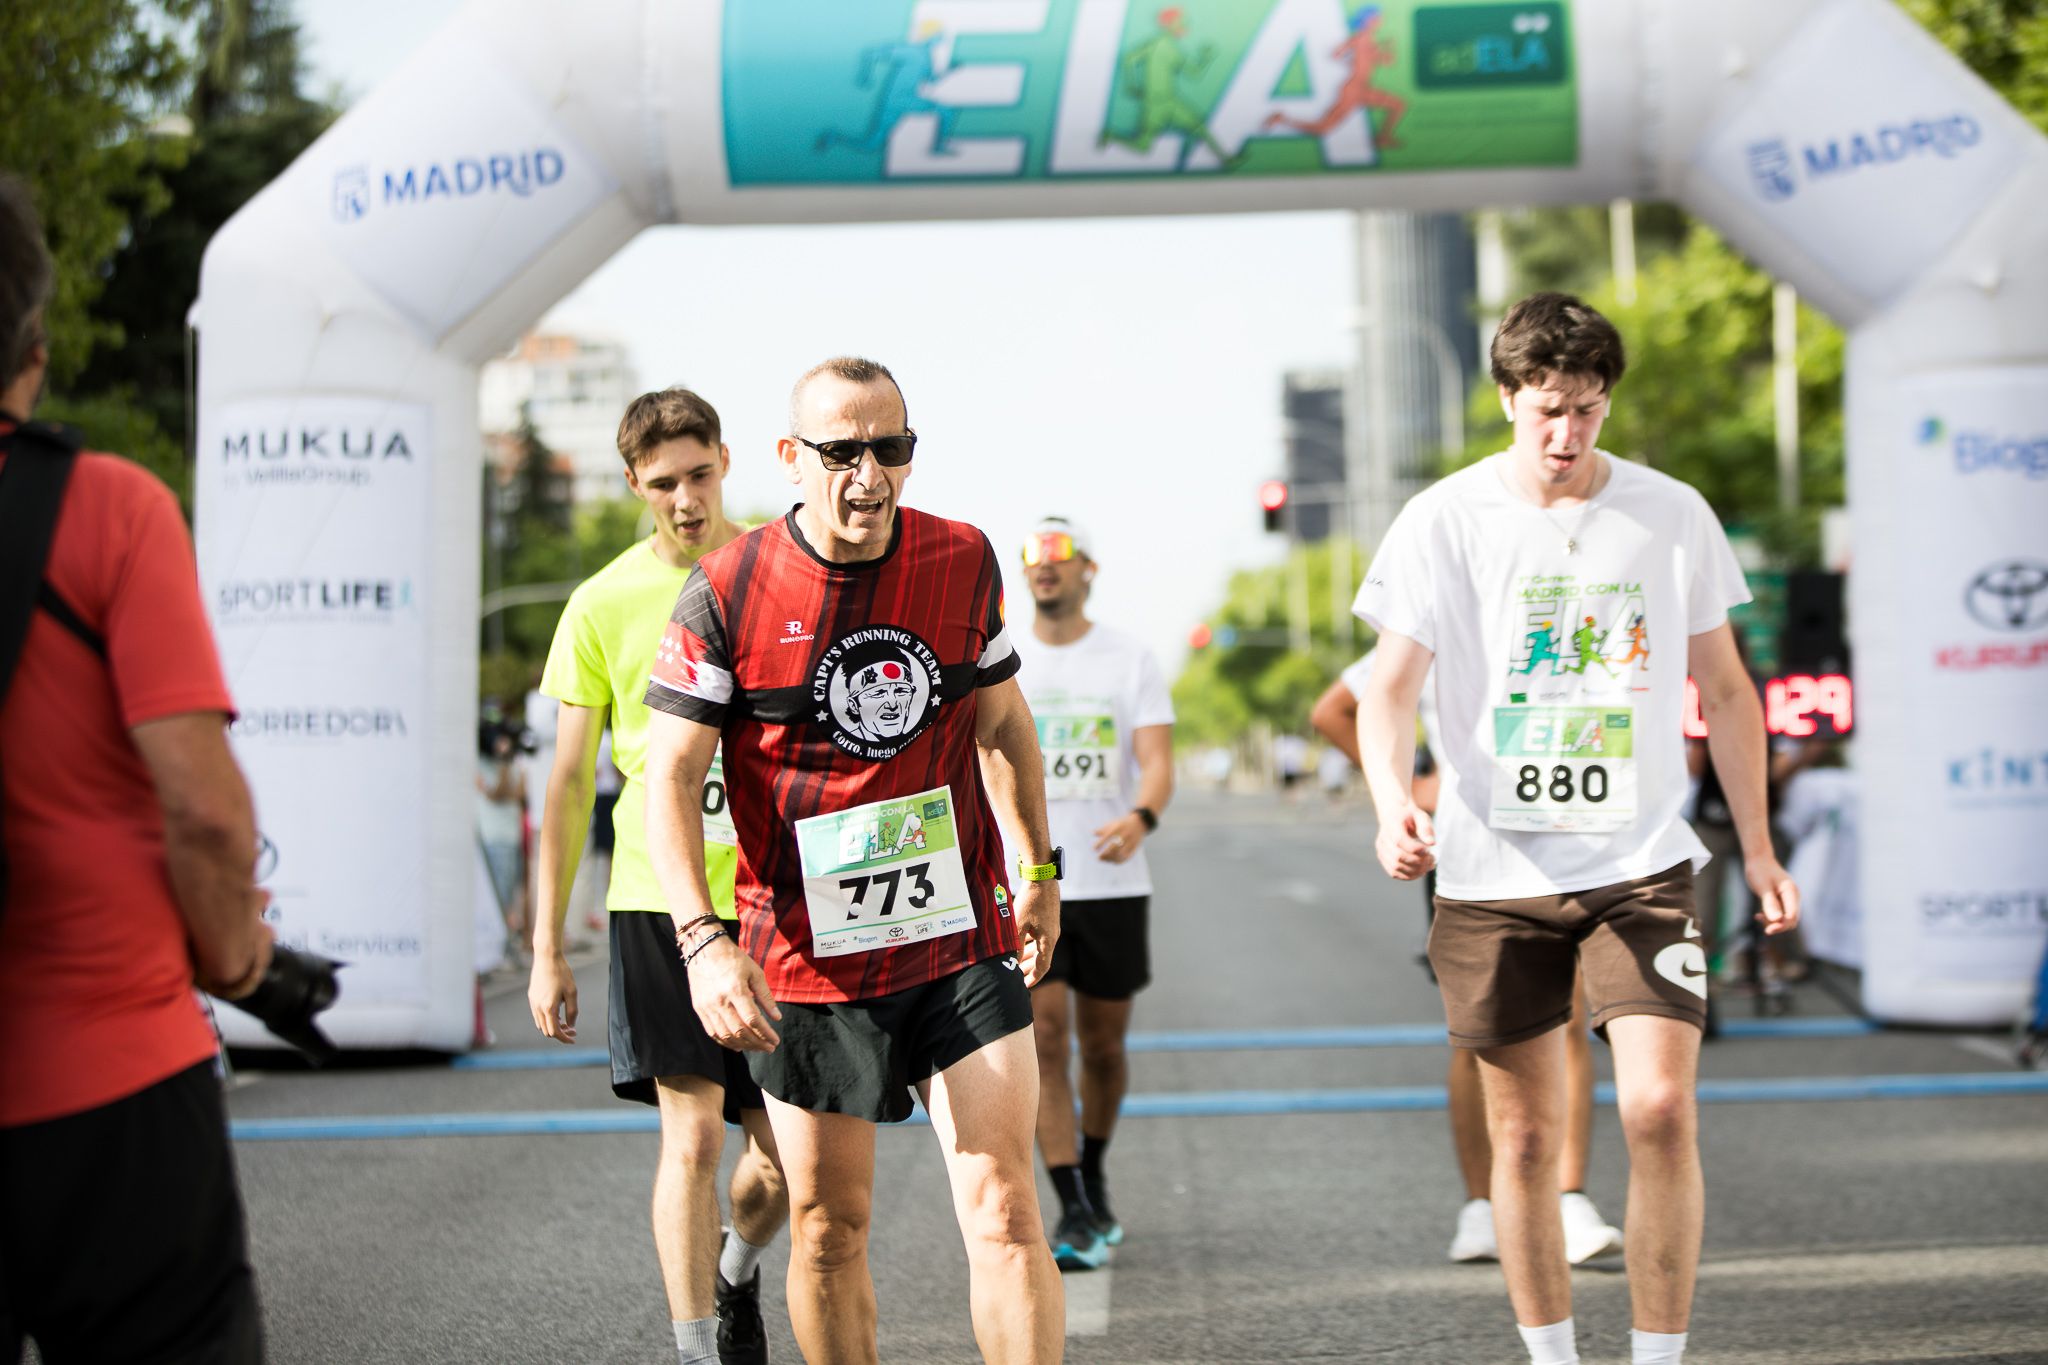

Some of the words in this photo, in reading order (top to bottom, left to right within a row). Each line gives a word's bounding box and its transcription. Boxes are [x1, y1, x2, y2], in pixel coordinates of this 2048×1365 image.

[1804, 115, 1981, 178] MADRID
[383, 148, 564, 203] MADRID
[223, 429, 413, 464] MUKUA
[1518, 586, 1580, 600] MADRID
[1584, 582, 1619, 596] CON
[1624, 582, 1642, 595] LA
[813, 646, 843, 702] CAPI'S
[841, 628, 913, 651] RUNNING
[913, 640, 943, 686] TEAM
[832, 730, 863, 756] Corro,
[1522, 718, 1604, 753] ELA
[1516, 764, 1609, 803] 880
[880, 807, 900, 819] CON
[903, 804, 916, 815] LA
[839, 811, 927, 865] ELA
[839, 862, 935, 921] 773
[946, 916, 967, 925] MADRID
[821, 939, 846, 947] MUKUA
